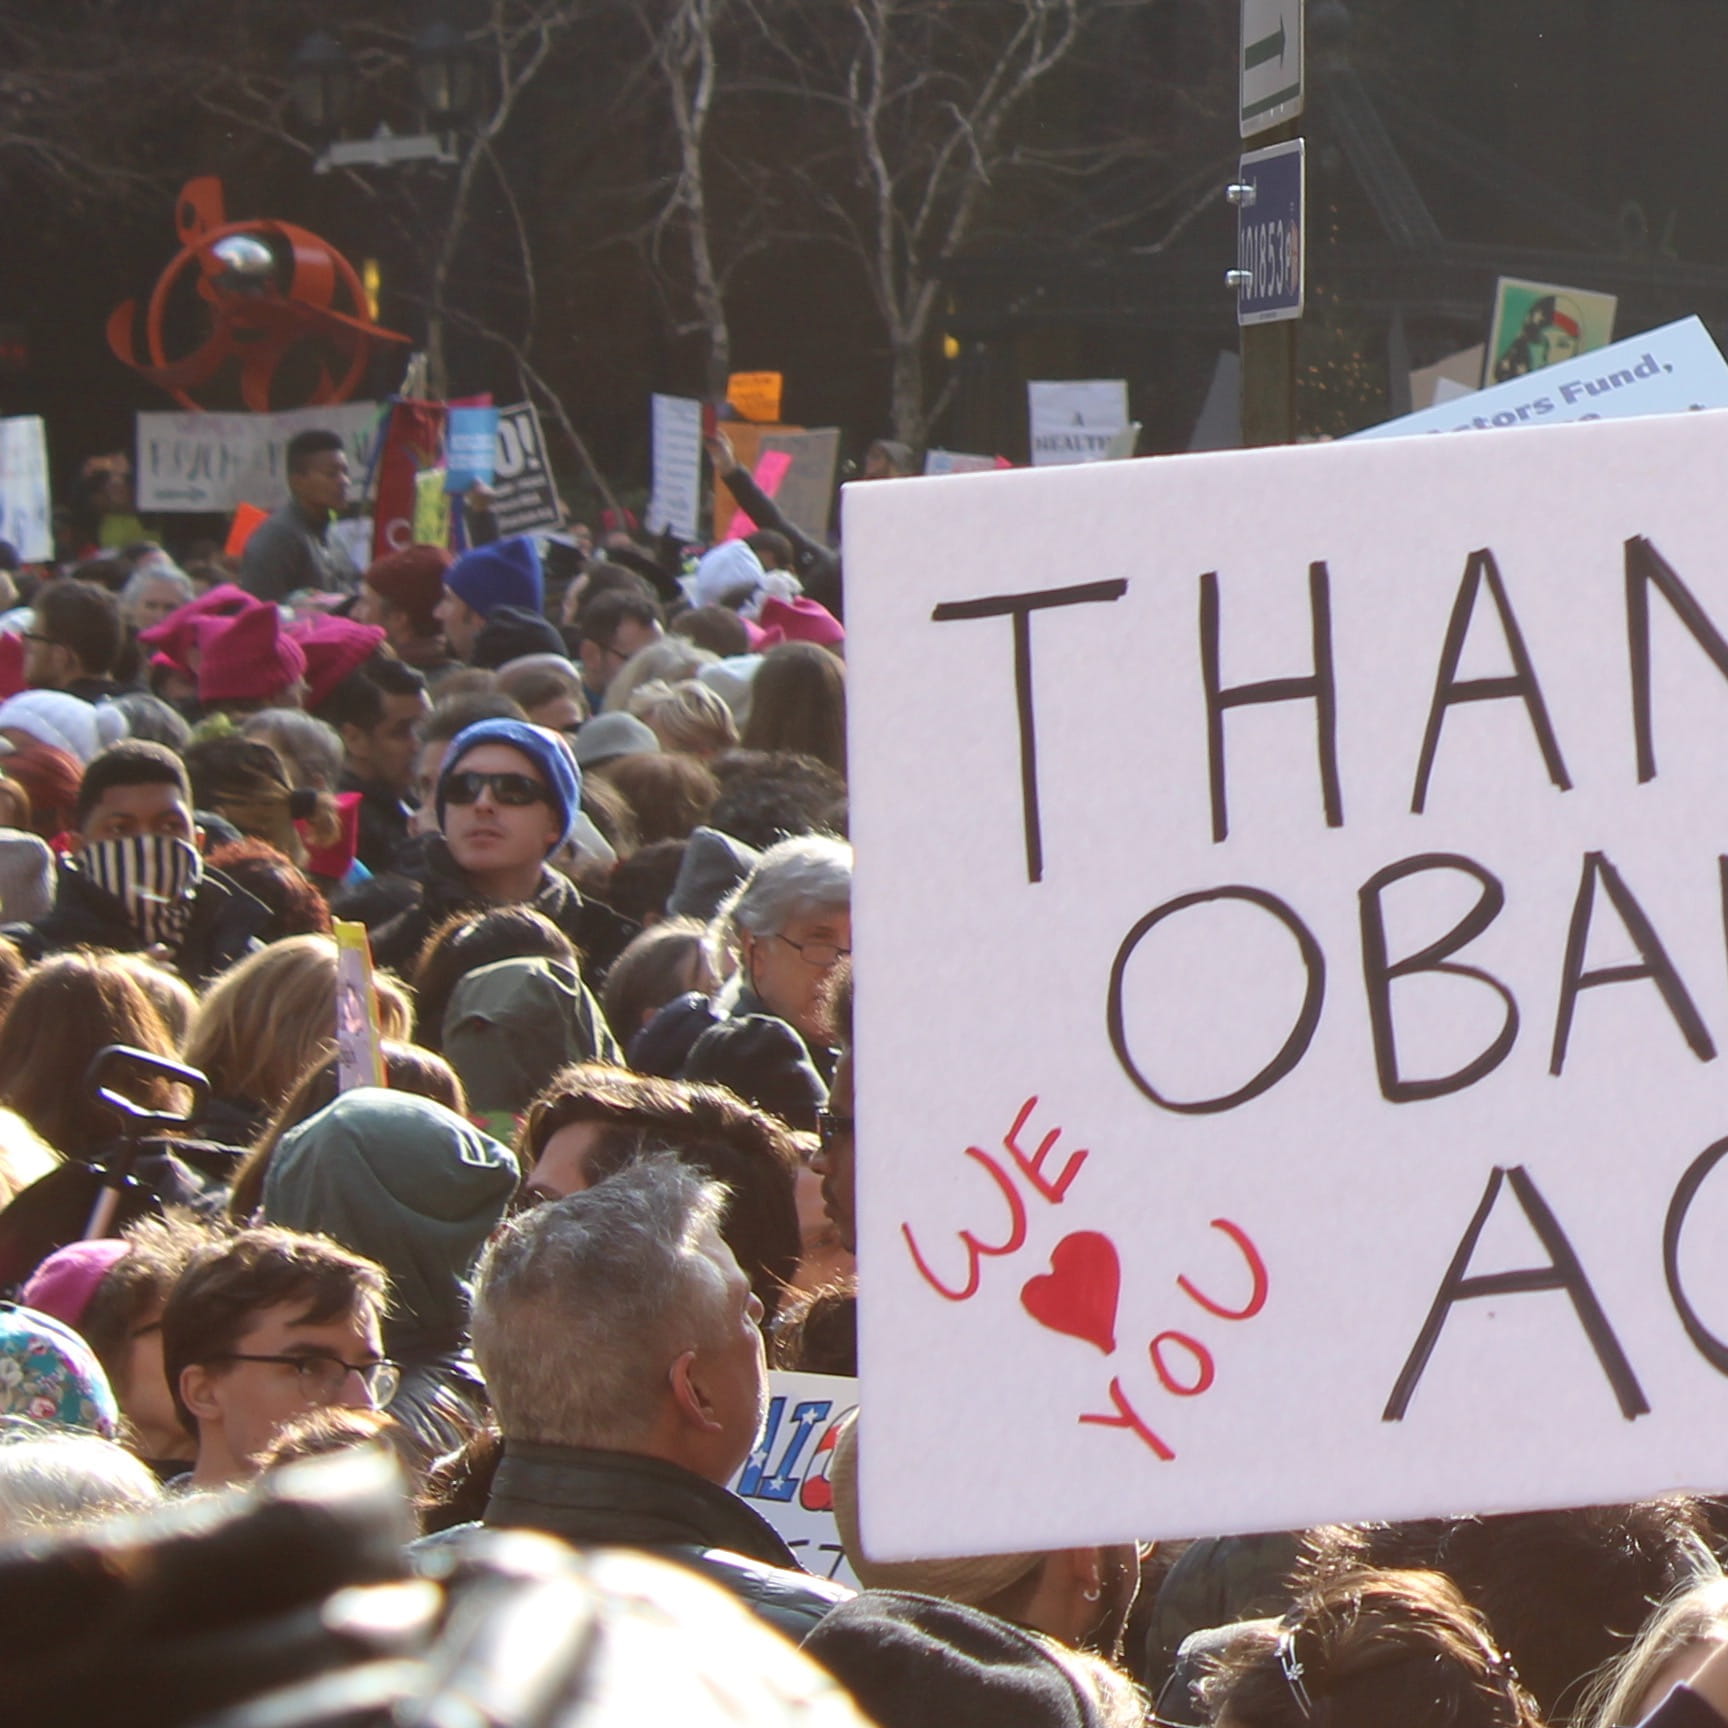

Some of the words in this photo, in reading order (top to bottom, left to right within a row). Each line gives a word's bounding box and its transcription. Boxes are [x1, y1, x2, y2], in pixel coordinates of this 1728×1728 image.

[1241, 220, 1284, 300] 101853
[1558, 352, 1674, 405] Fund,
[902, 1095, 1090, 1302] WE
[1079, 1218, 1268, 1462] YOU
